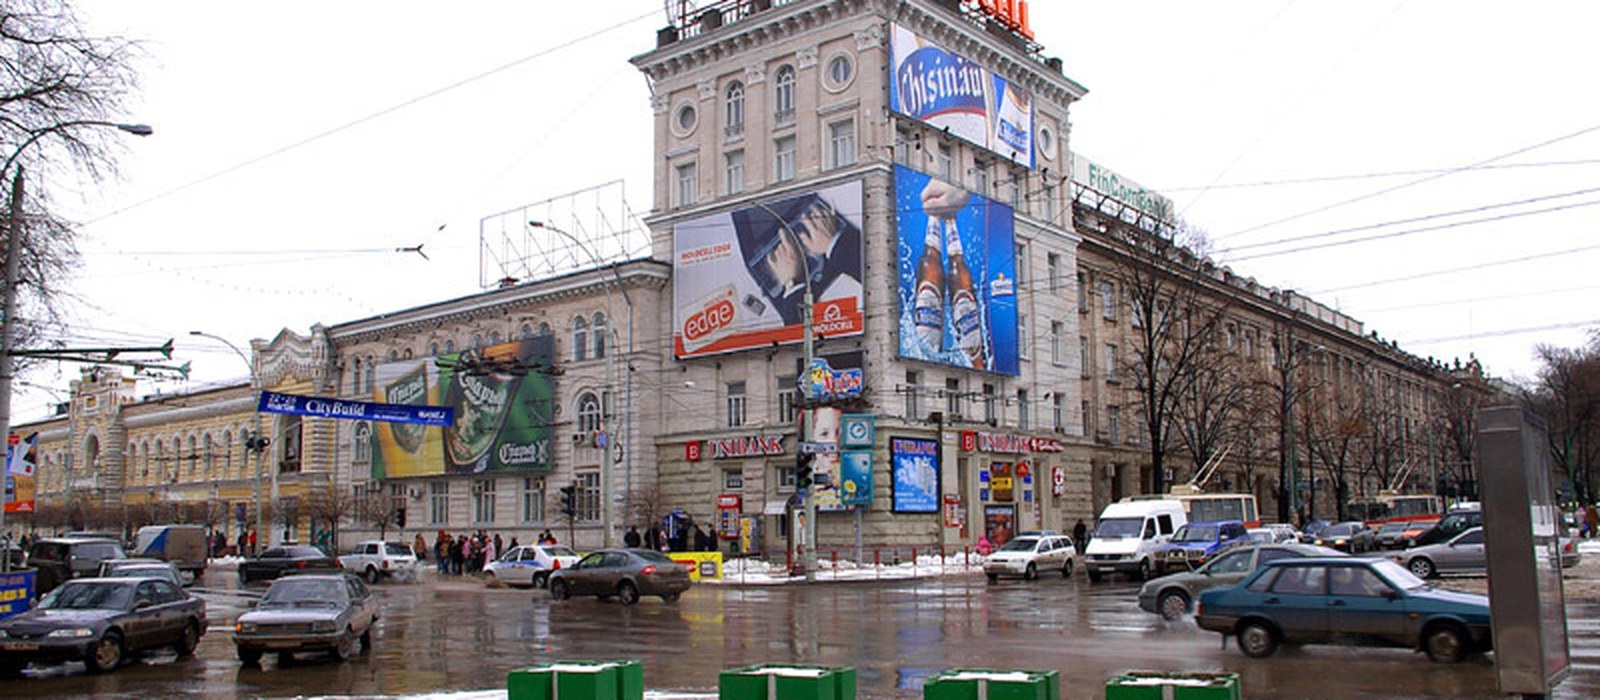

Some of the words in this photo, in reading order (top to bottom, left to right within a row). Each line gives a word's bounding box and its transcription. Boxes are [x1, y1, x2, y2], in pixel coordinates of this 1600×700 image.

[687, 302, 731, 337] edge
[305, 400, 366, 417] CityBuild
[708, 435, 785, 459] UNIBANK
[979, 432, 1031, 453] UNIBANK
